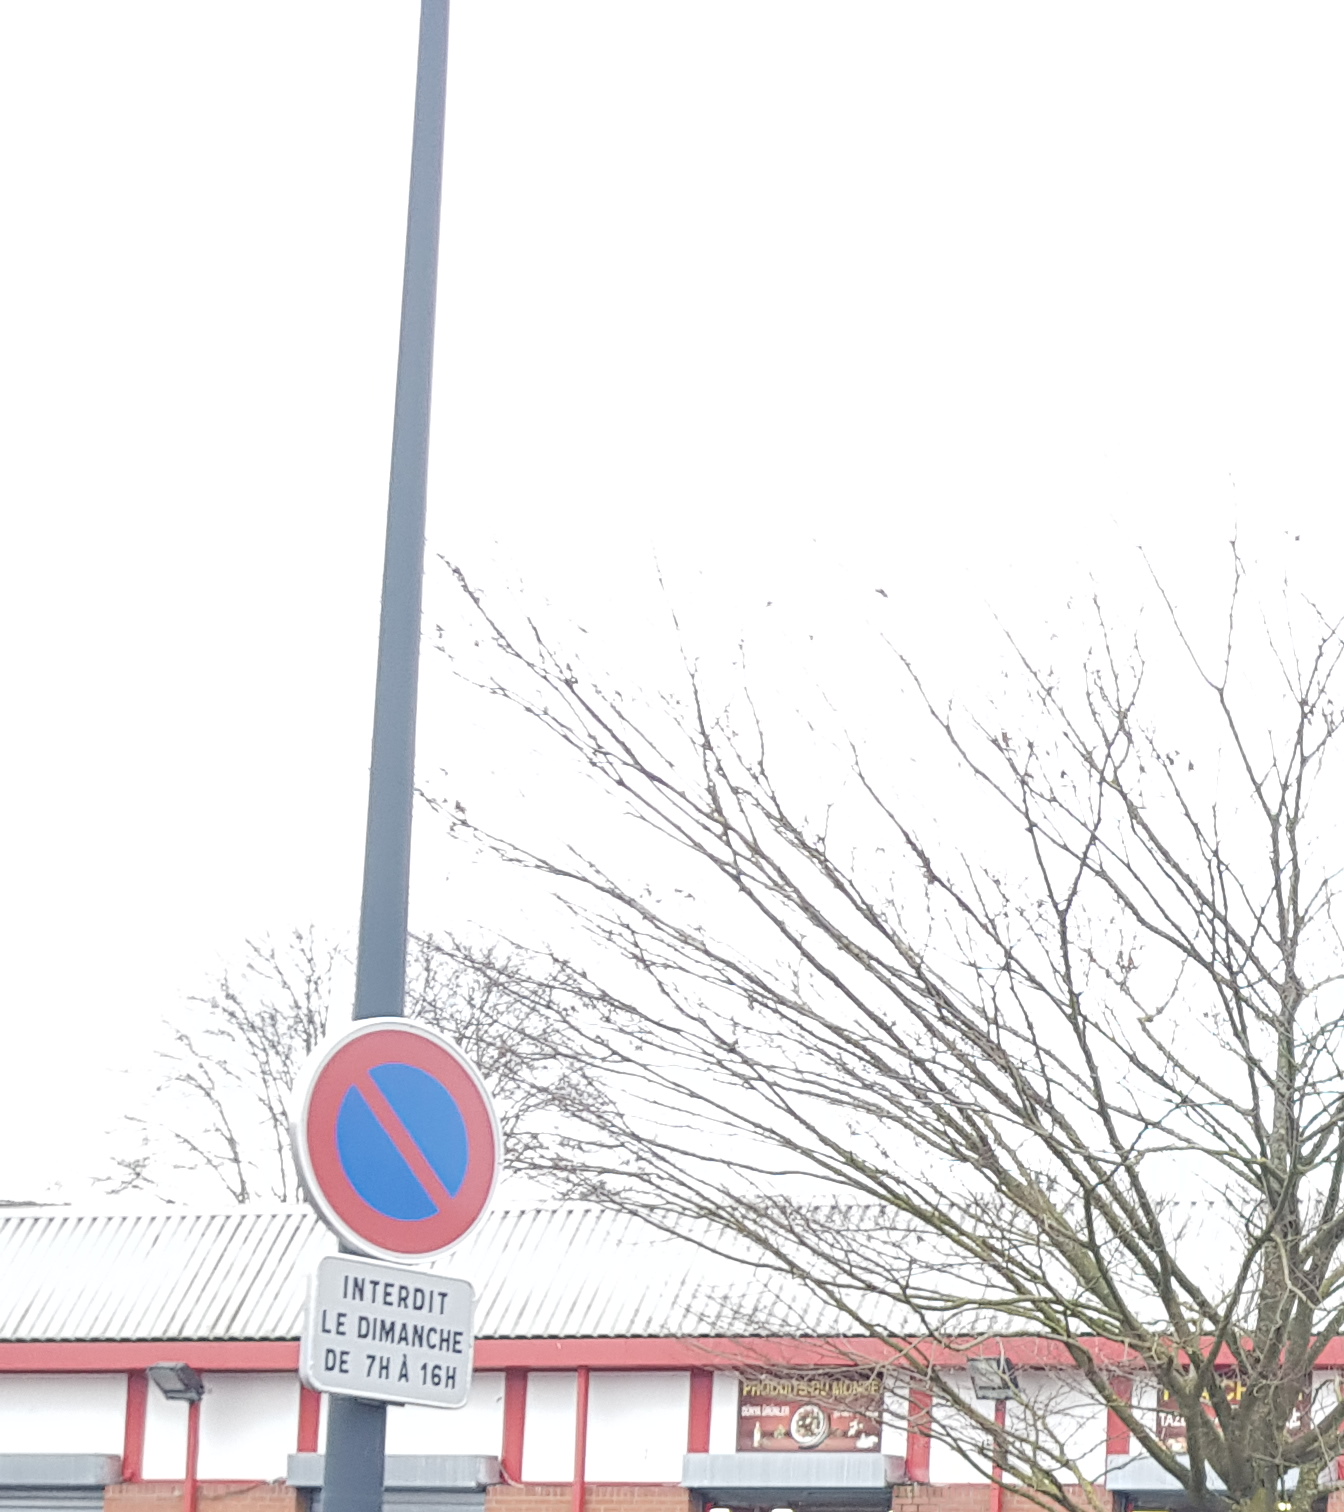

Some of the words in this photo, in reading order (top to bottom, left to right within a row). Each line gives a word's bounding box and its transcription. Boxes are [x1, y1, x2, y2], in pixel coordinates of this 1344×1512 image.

[343, 1275, 448, 1315] INTERDIT
[321, 1309, 347, 1336] LE
[357, 1315, 464, 1354] DIMANCHE
[324, 1348, 350, 1374] DE
[365, 1354, 391, 1380] 7H
[397, 1353, 410, 1383] À
[420, 1362, 457, 1390] 16H
